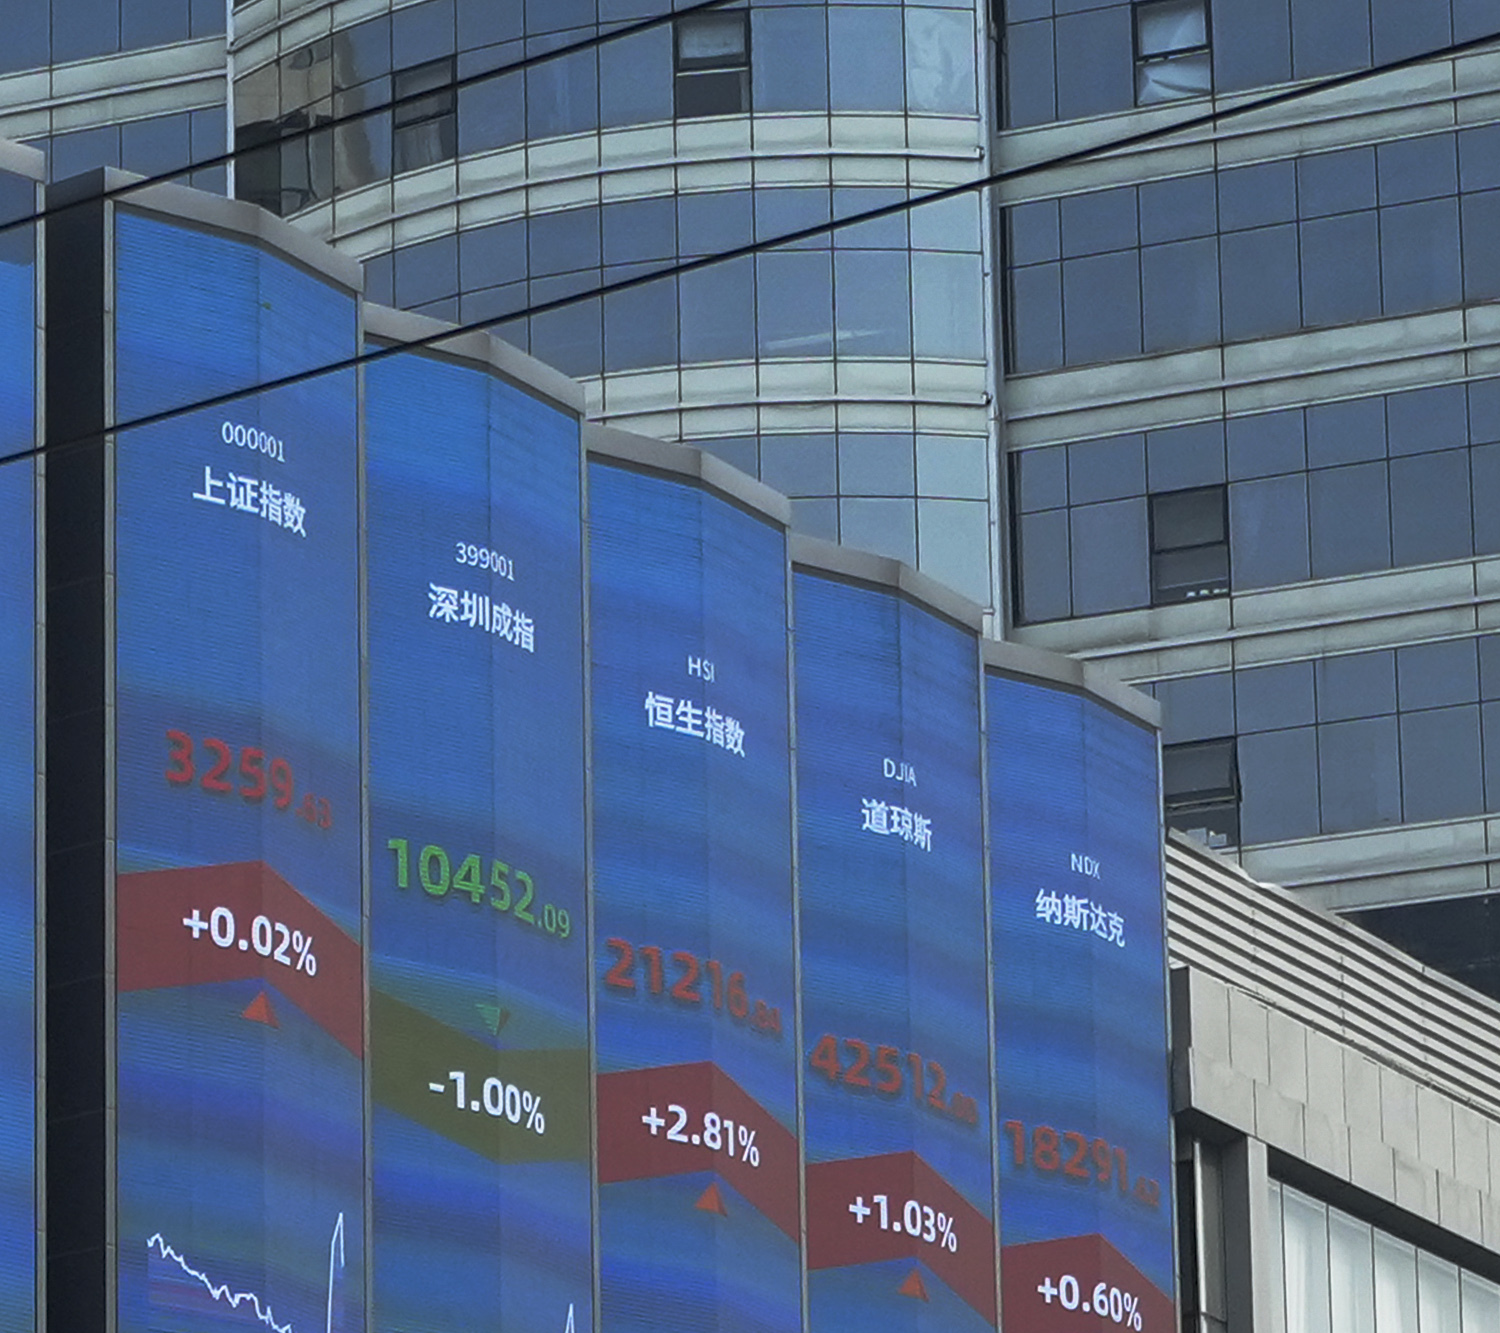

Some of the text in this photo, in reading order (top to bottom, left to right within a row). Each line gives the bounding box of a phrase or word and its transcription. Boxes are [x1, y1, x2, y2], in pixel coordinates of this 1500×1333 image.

[221, 421, 286, 463] 000001
[193, 465, 308, 538] 上证指数
[455, 541, 516, 582] 399001
[428, 582, 535, 653] 深圳成指
[687, 654, 716, 684] HSI
[644, 690, 746, 759] 恒生指数
[165, 729, 333, 829] 3259.63
[883, 756, 917, 790] DJIA
[861, 797, 933, 853] 道琼斯
[386, 837, 571, 940] 10452.09
[1070, 851, 1101, 881] NDX
[182, 905, 318, 977] +0.02%
[1035, 887, 1127, 949] 纳斯达克
[604, 937, 783, 1038] 21216.84
[428, 1070, 546, 1135] -1.00%
[641, 1102, 761, 1168] +2.81%
[848, 1194, 958, 1254] +1.03%
[1037, 1273, 1143, 1333] +0.60%
